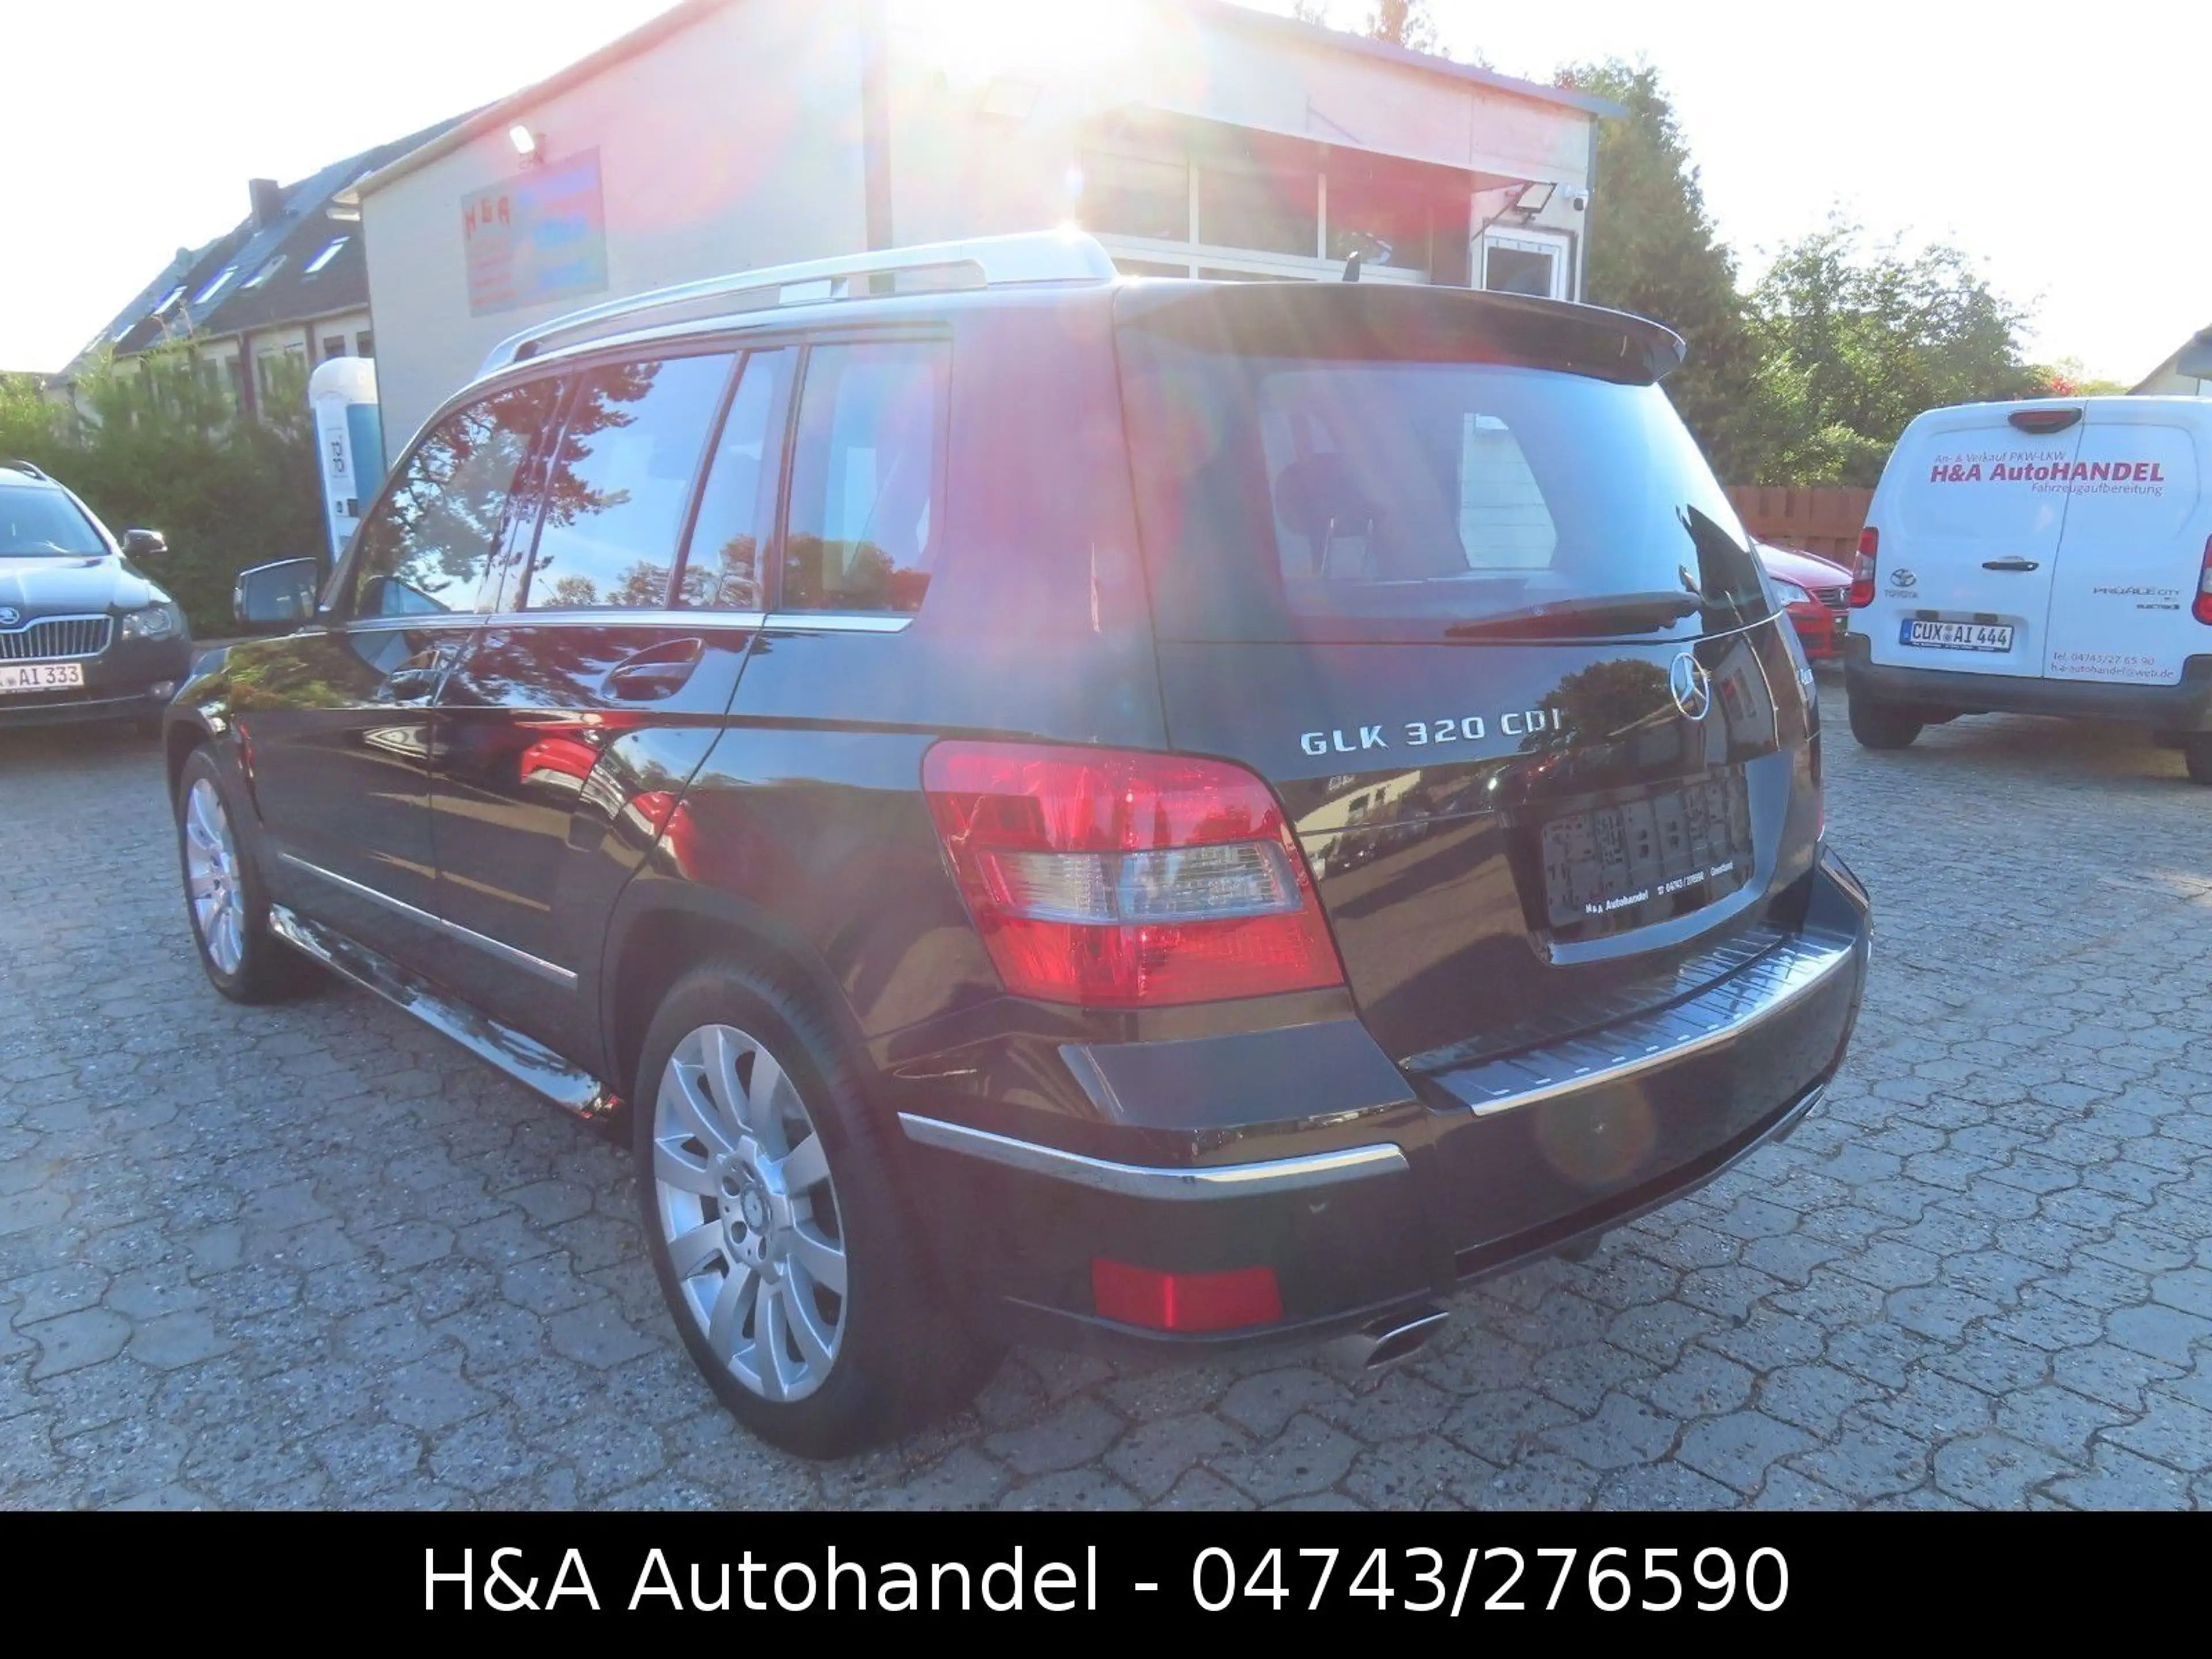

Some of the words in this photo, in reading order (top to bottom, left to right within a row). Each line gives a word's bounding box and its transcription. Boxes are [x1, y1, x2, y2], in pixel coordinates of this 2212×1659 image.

[1966, 452, 2007, 462] Verkauf
[1930, 463, 1982, 482] H&A
[1989, 462, 2165, 482] AutoHANDEL
[2032, 482, 2163, 496] Fahrzeugaufbereitung
[1884, 589, 1918, 599] TOYOTA
[1912, 623, 1943, 641] CUX
[1953, 626, 1972, 643] AI
[1977, 627, 2007, 646] 444
[20, 668, 41, 686] AI
[44, 666, 79, 684] 333
[1301, 725, 1389, 756] GLK
[1404, 716, 1485, 745] 320
[1501, 707, 1560, 735] CDI
[1605, 889, 1649, 911] Autohandel
